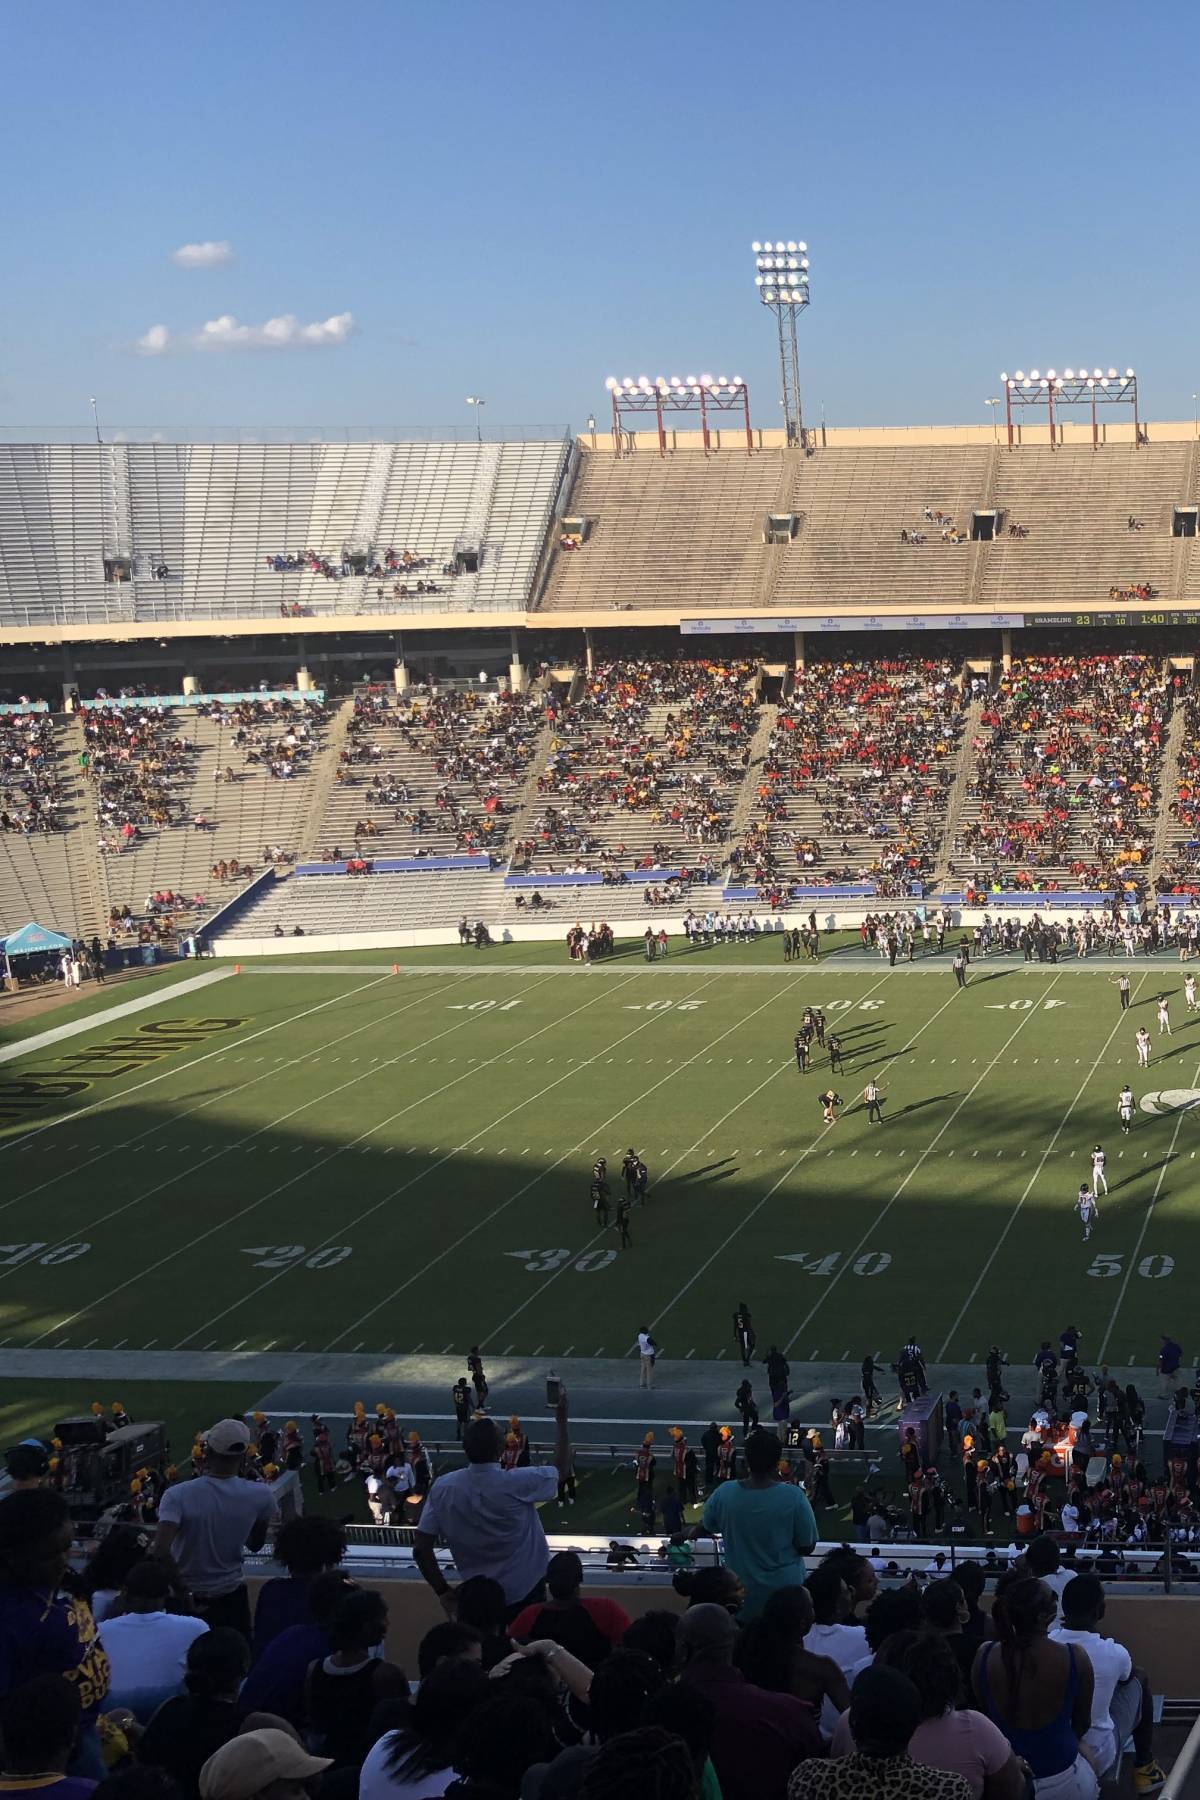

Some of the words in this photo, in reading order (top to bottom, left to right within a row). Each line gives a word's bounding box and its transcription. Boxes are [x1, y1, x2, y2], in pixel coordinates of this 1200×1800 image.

[1076, 616, 1090, 625] 23
[1141, 614, 1165, 625] 1:40
[1186, 616, 1198, 624] 20
[0, 1243, 92, 1266] 10
[251, 1246, 353, 1269] 20
[525, 1249, 617, 1272] 30
[803, 1252, 892, 1277] 40
[1086, 1254, 1175, 1278] 50
[787, 1432, 800, 1446] 12
